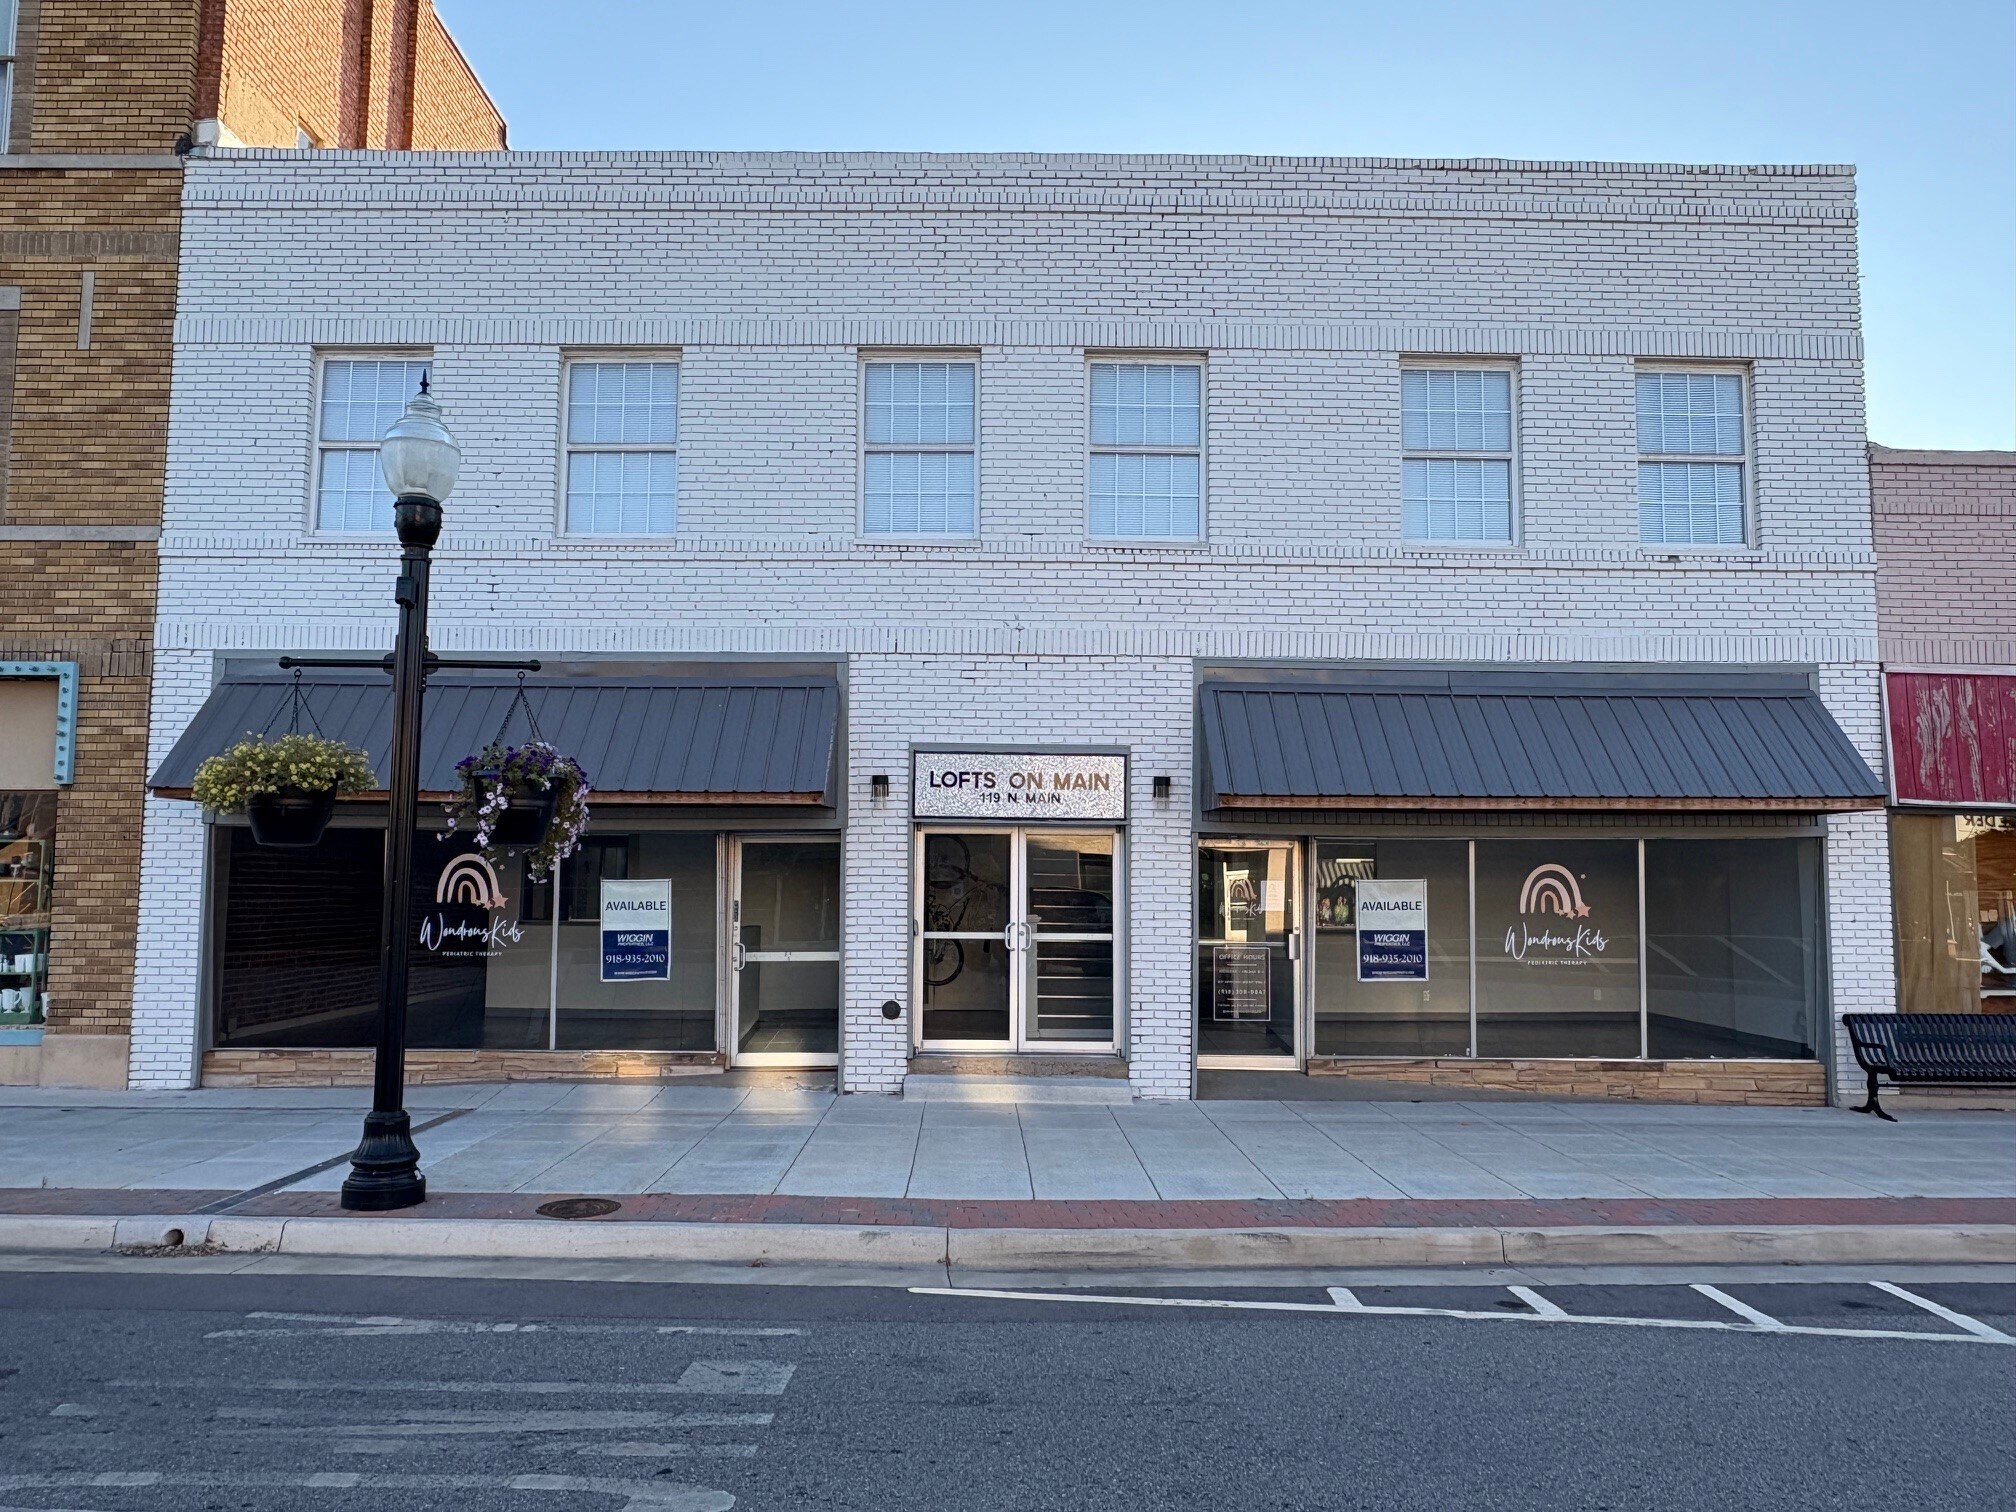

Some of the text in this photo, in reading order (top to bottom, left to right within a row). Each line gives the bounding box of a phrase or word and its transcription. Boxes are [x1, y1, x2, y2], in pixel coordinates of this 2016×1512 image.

[929, 771, 1110, 791] LOFTS ON MAIN
[979, 792, 1000, 804] 119
[1025, 793, 1061, 804] MAIN
[605, 900, 667, 911] AVAILABLE
[1361, 900, 1423, 911] AVAILABLE
[617, 933, 653, 943] WIGGIN
[1374, 933, 1410, 943] WIGGIN
[605, 953, 666, 964] 918-935-2010
[1363, 953, 1423, 964] 918-935-2010
